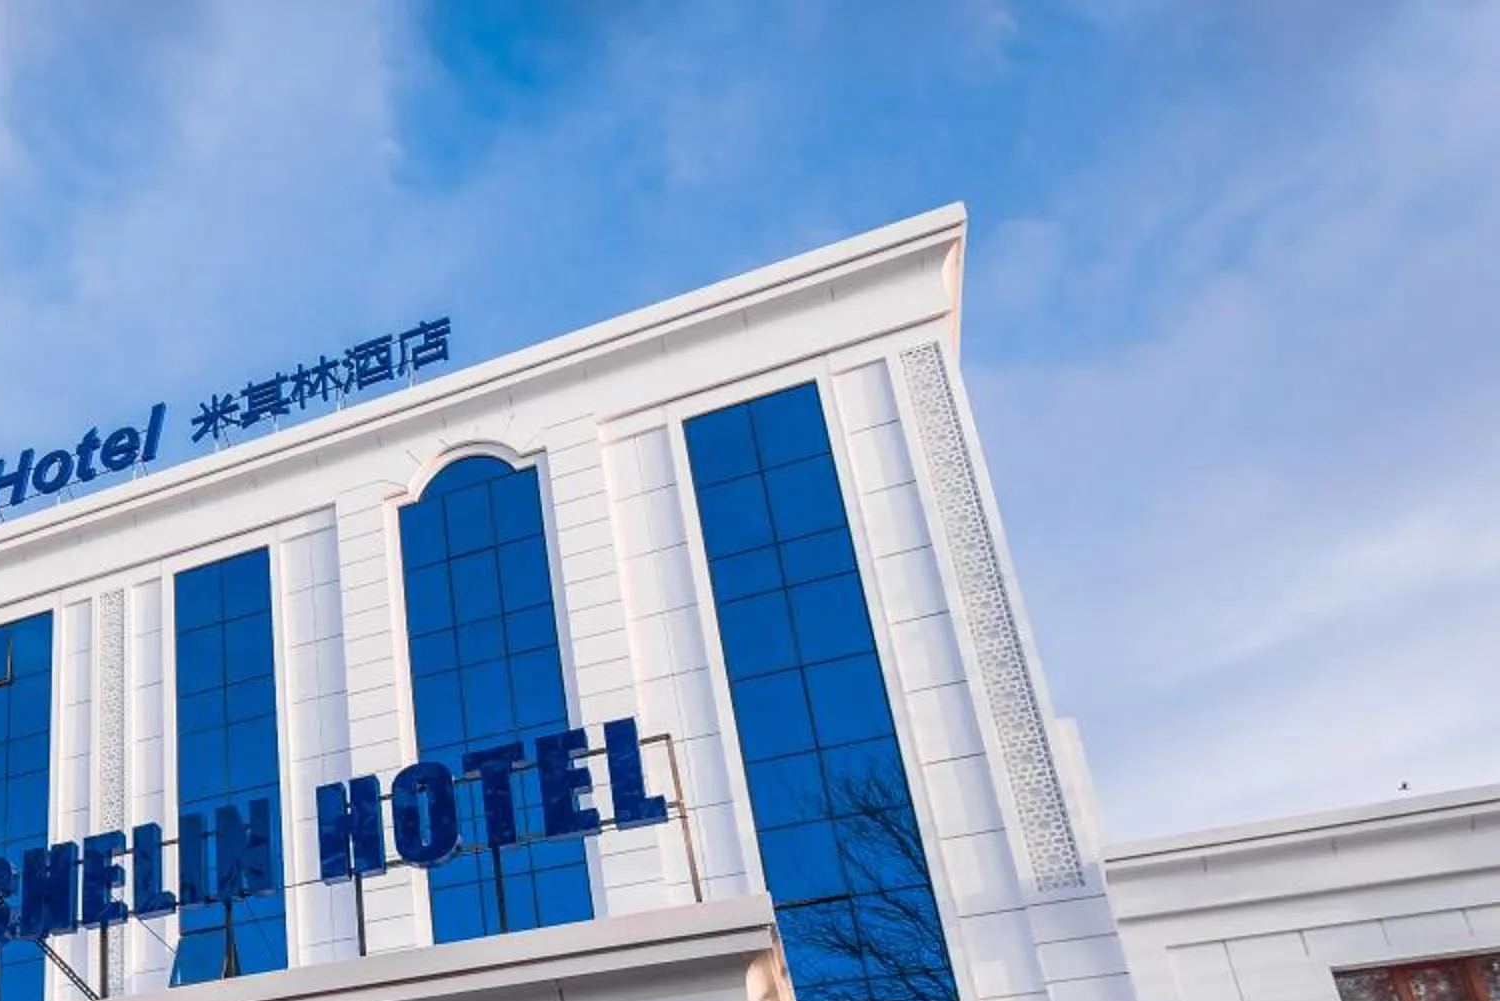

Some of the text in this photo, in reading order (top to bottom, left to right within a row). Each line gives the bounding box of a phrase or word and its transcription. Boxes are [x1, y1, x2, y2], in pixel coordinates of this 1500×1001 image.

[191, 316, 451, 443] 米其林酒店
[315, 717, 668, 885] HOTEL
